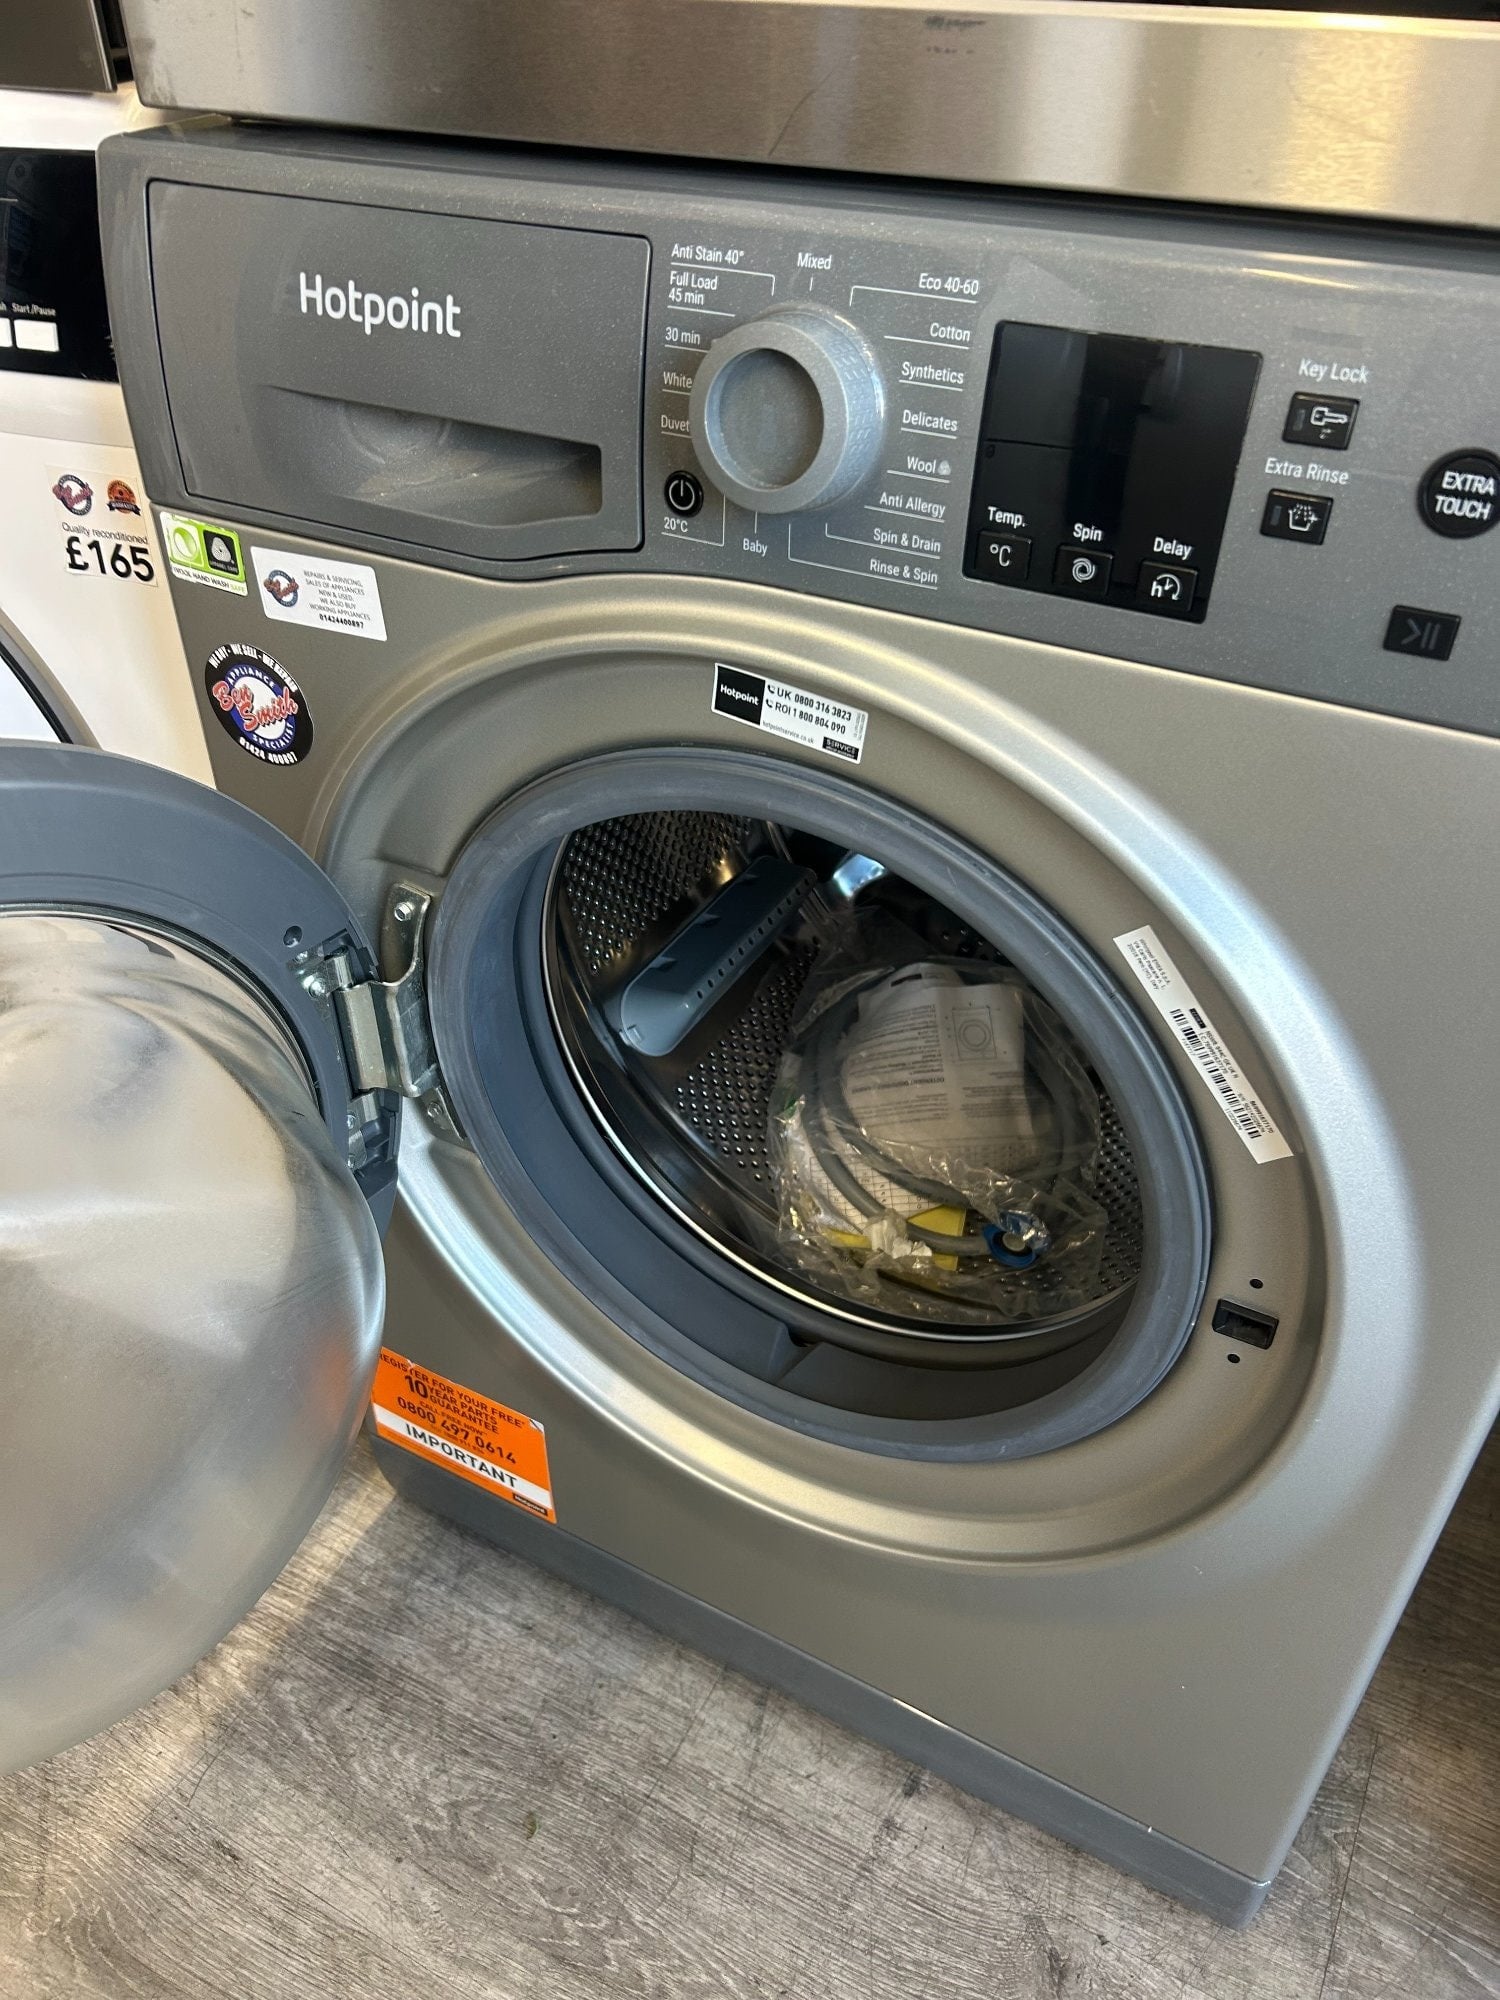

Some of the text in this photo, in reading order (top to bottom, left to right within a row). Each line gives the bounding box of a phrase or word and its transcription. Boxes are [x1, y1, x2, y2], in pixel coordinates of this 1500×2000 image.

[671, 244, 693, 260] Anti
[696, 247, 722, 263] Stain
[797, 253, 831, 270] Mixed
[670, 272, 717, 290] Full Load
[919, 273, 979, 295] Eco 40-60
[299, 271, 462, 338] Hotpoint
[669, 288, 704, 305] 45 min
[665, 327, 700, 344] 30 min
[929, 323, 971, 342] Cotton
[901, 362, 964, 385] Synthetics
[1298, 358, 1369, 383] Key Lock
[661, 416, 689, 432] Duvet
[903, 410, 957, 431] Delicates
[907, 456, 936, 474] Wool
[1265, 457, 1349, 485] Extra Rinse
[1441, 471, 1496, 496] EXTRA
[879, 492, 945, 519] Anti Allergy
[1435, 495, 1491, 521] TOUCH
[664, 517, 688, 533] 20°C
[988, 506, 1026, 529] Temp.
[62, 522, 149, 545] Quality reconditioned
[873, 528, 941, 552] Spin & Drain
[1073, 522, 1103, 542] Spin
[66, 535, 154, 582] £165
[743, 538, 767, 557] Baby
[1153, 537, 1192, 560] Delay
[869, 559, 938, 586] Rinse & Spin
[305, 579, 321, 587] SALES
[330, 583, 365, 595] APPLIANCES
[309, 603, 370, 620] WORKING APPLIANCES
[318, 613, 364, 628] 01424400897
[227, 666, 275, 689] APPLIANCE
[212, 680, 254, 712] Ben
[720, 683, 759, 706] Hotpoint
[776, 687, 851, 721] UK 0800 316 3823
[239, 686, 299, 732] Smith
[775, 702, 790, 714] ROI
[793, 708, 796, 716] 1
[798, 710, 813, 722] 800
[814, 716, 829, 728] 804
[830, 721, 845, 734] 090
[252, 722, 294, 750] SPECIALIST
[403, 1373, 497, 1425] 10 YEAR PARTS
[432, 1378, 453, 1395] FOR
[458, 1390, 487, 1412] YOUR
[429, 1393, 498, 1435] GUARANTEE
[397, 1396, 435, 1424] 0800
[441, 1418, 469, 1441] 497
[475, 1435, 515, 1464] 0614
[405, 1423, 518, 1490] IMPORTANT
